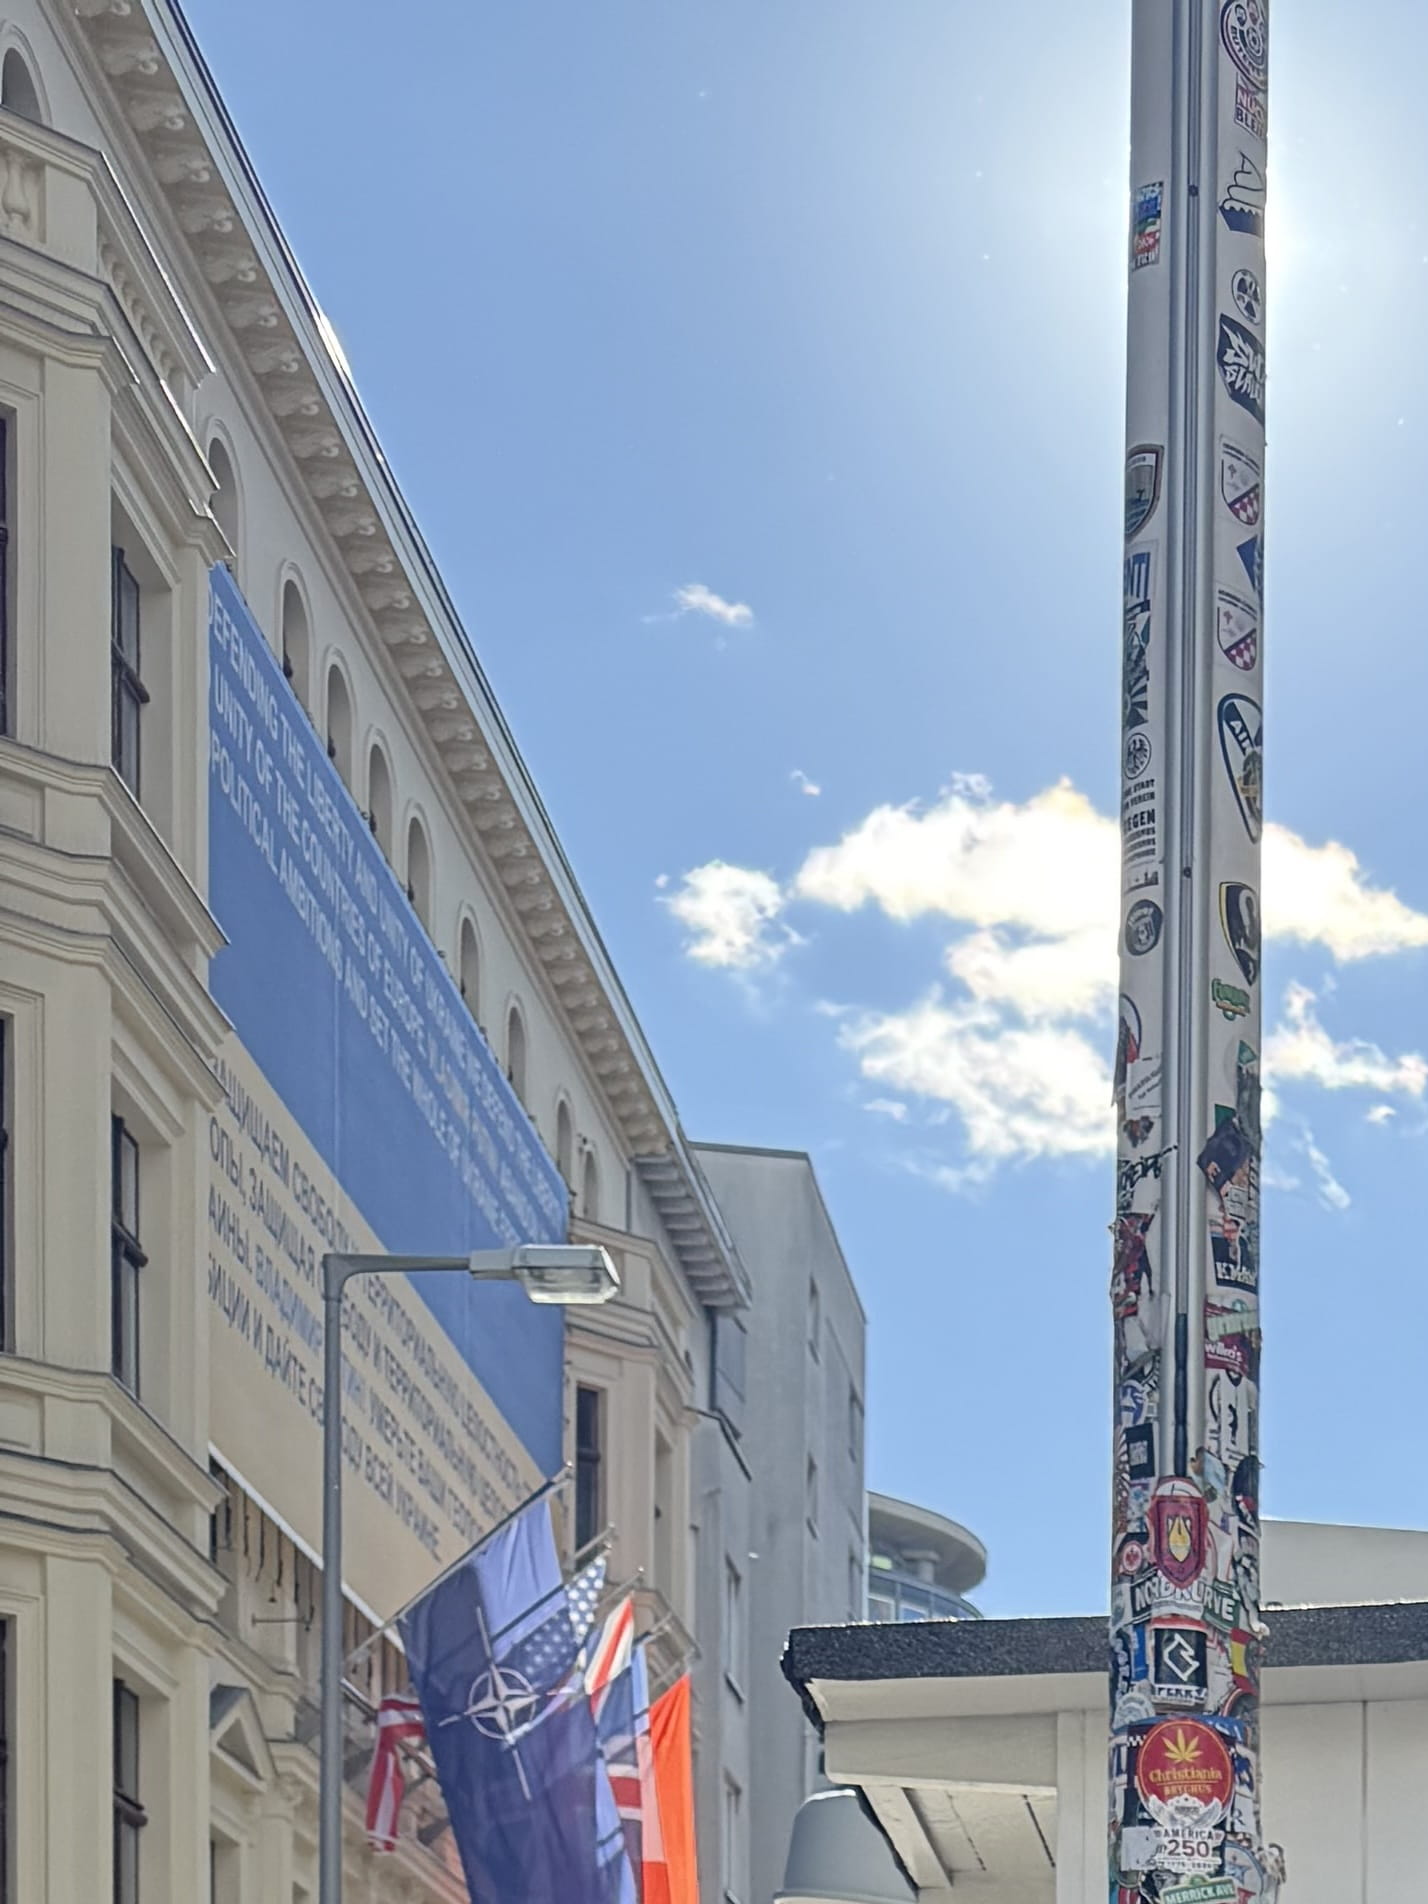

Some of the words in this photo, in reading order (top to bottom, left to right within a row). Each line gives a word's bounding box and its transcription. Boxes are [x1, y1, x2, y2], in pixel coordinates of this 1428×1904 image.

[211, 735, 278, 875] POLITICAL
[280, 847, 343, 982] AMBITIONS
[343, 956, 368, 1019] AND
[215, 663, 254, 762] UNITY
[255, 738, 274, 796] OF
[275, 769, 302, 846] THE
[302, 820, 367, 957] COUNTRIES
[367, 930, 385, 980] OF
[281, 713, 305, 791] THE
[307, 760, 355, 873] LIBERTY
[355, 852, 378, 916] AND
[1161, 1828, 1214, 1841] AMERICA
